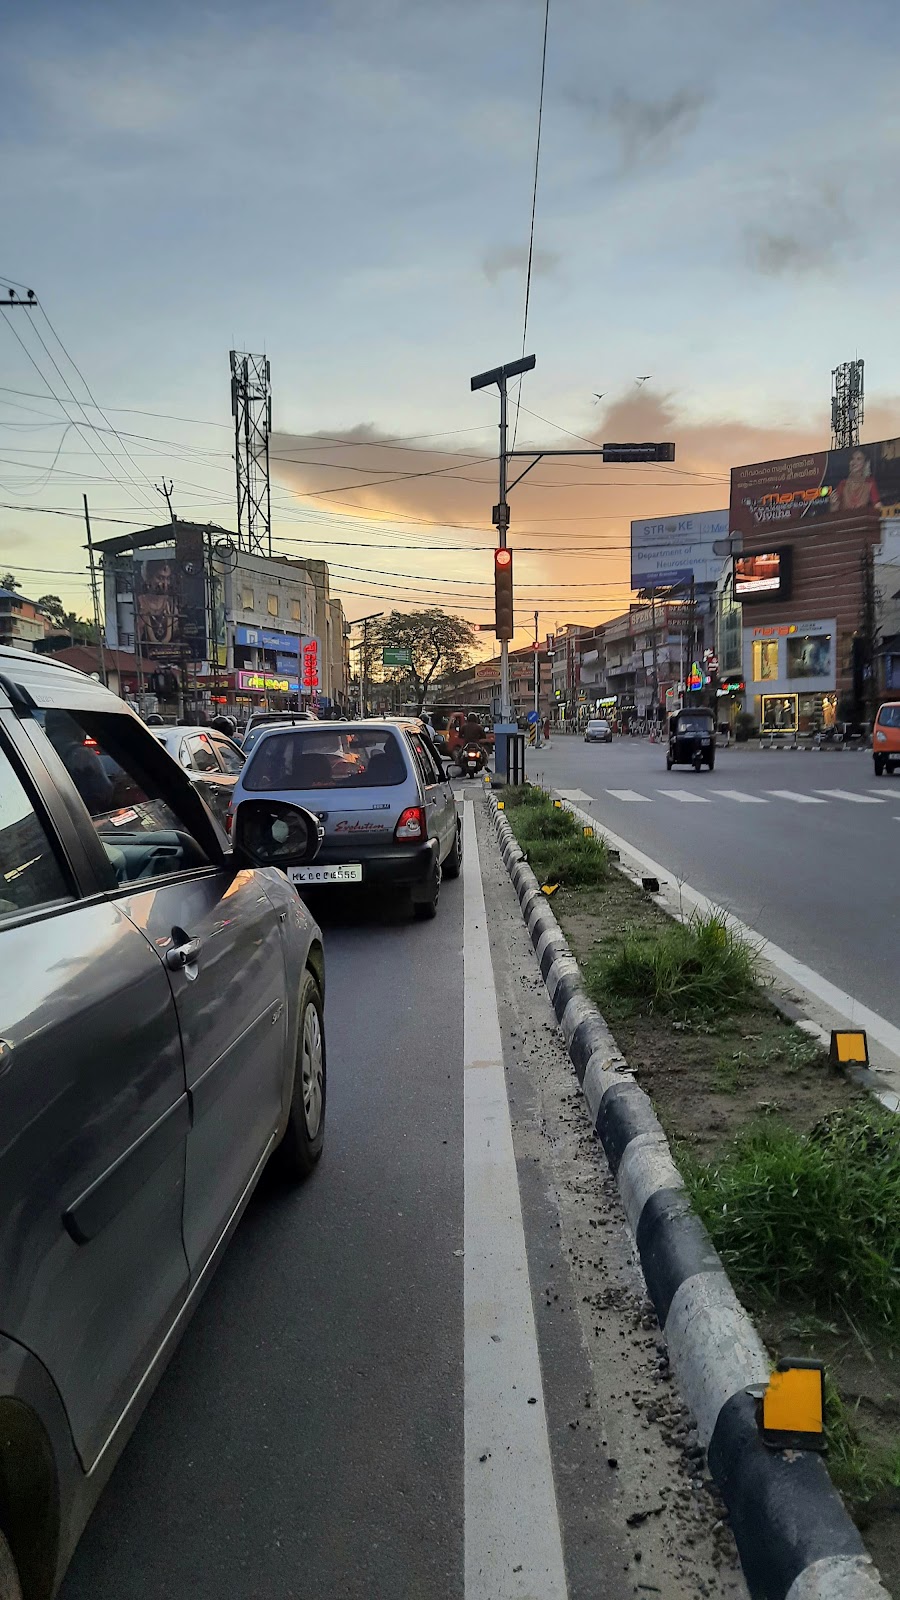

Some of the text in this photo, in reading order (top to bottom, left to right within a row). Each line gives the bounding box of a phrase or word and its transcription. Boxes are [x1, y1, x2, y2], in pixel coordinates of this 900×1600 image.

[643, 521, 694, 535] STRKE
[637, 547, 692, 561] Department of
[631, 607, 665, 625] SPENCER
[334, 820, 384, 832] Evolution
